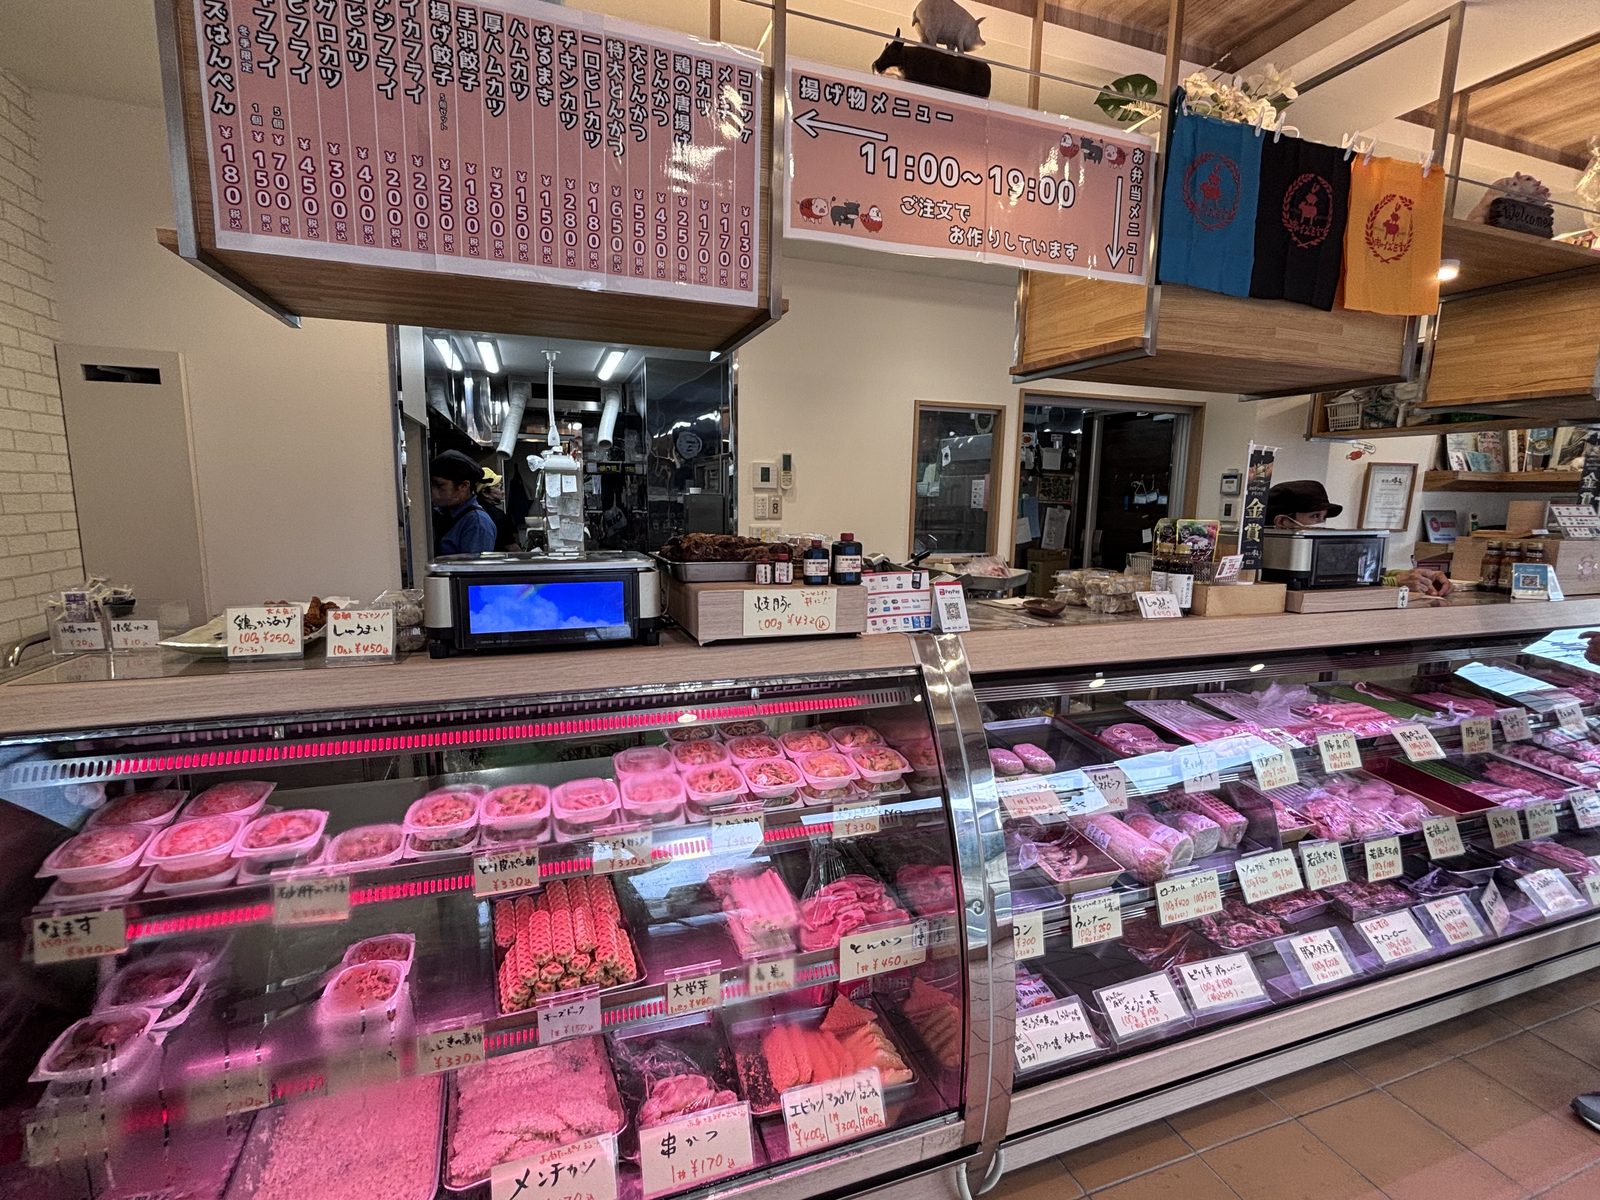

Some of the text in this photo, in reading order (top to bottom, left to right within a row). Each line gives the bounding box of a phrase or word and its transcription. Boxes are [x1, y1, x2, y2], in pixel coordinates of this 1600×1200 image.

[253, 0, 280, 78] フライ
[428, 1, 454, 87] 揚げ餃子
[456, 5, 481, 92] 手羽餃子
[482, 11, 505, 118] 厚ハムカツ
[508, 19, 529, 101] ハムカツ
[534, 25, 554, 107] はるまき
[558, 30, 579, 131] チキンカツ
[581, 34, 603, 149] 一口ヒレカツ
[606, 38, 626, 159] 特大とんかつ
[629, 45, 648, 143] 大とんかつ
[652, 49, 670, 128] とんかつ
[695, 60, 713, 118] 串カツ
[799, 76, 954, 123] 揚げ物メニュー
[899, 196, 971, 222] ご注文で
[948, 226, 1078, 261] お作りしています
[1126, 149, 1145, 274] お弁当メニュー
[1244, 497, 1265, 542] 金賞
[850, 936, 903, 954] とんかつ
[661, 1130, 719, 1159] 串かつ
